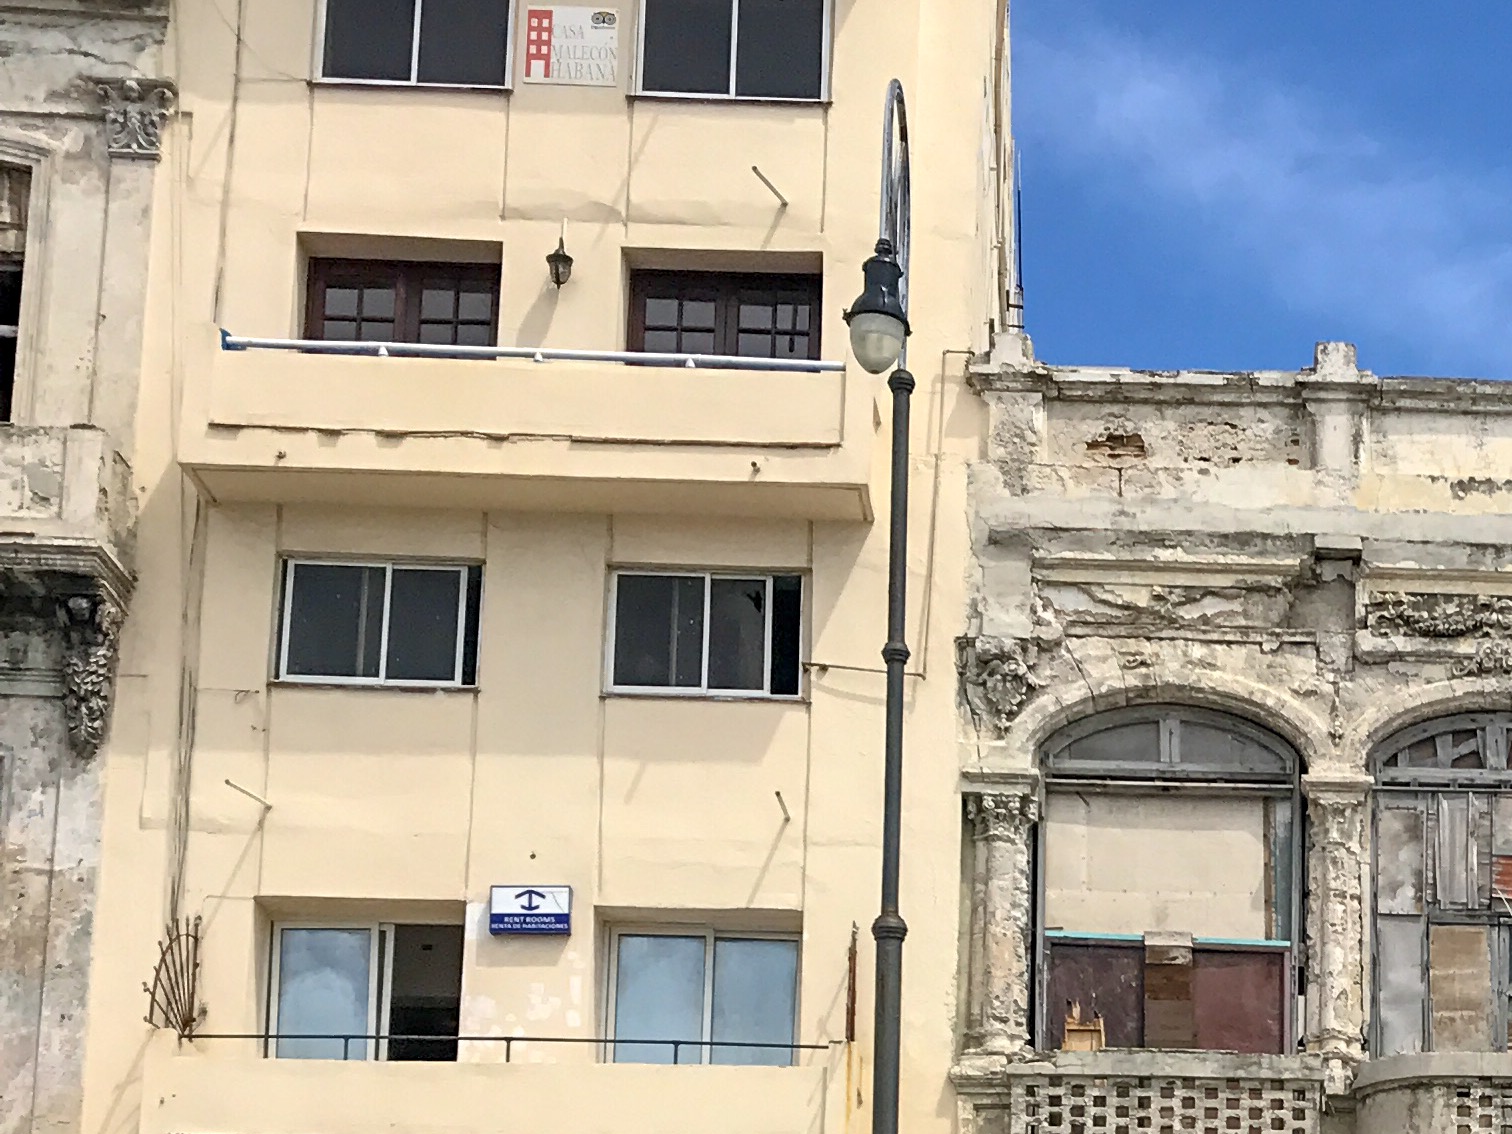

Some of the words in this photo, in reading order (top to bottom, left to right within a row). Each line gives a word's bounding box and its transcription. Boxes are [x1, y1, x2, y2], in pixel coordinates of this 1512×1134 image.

[552, 23, 584, 40] CASA
[551, 42, 617, 61] MALECÓN
[551, 60, 616, 82] HABANA
